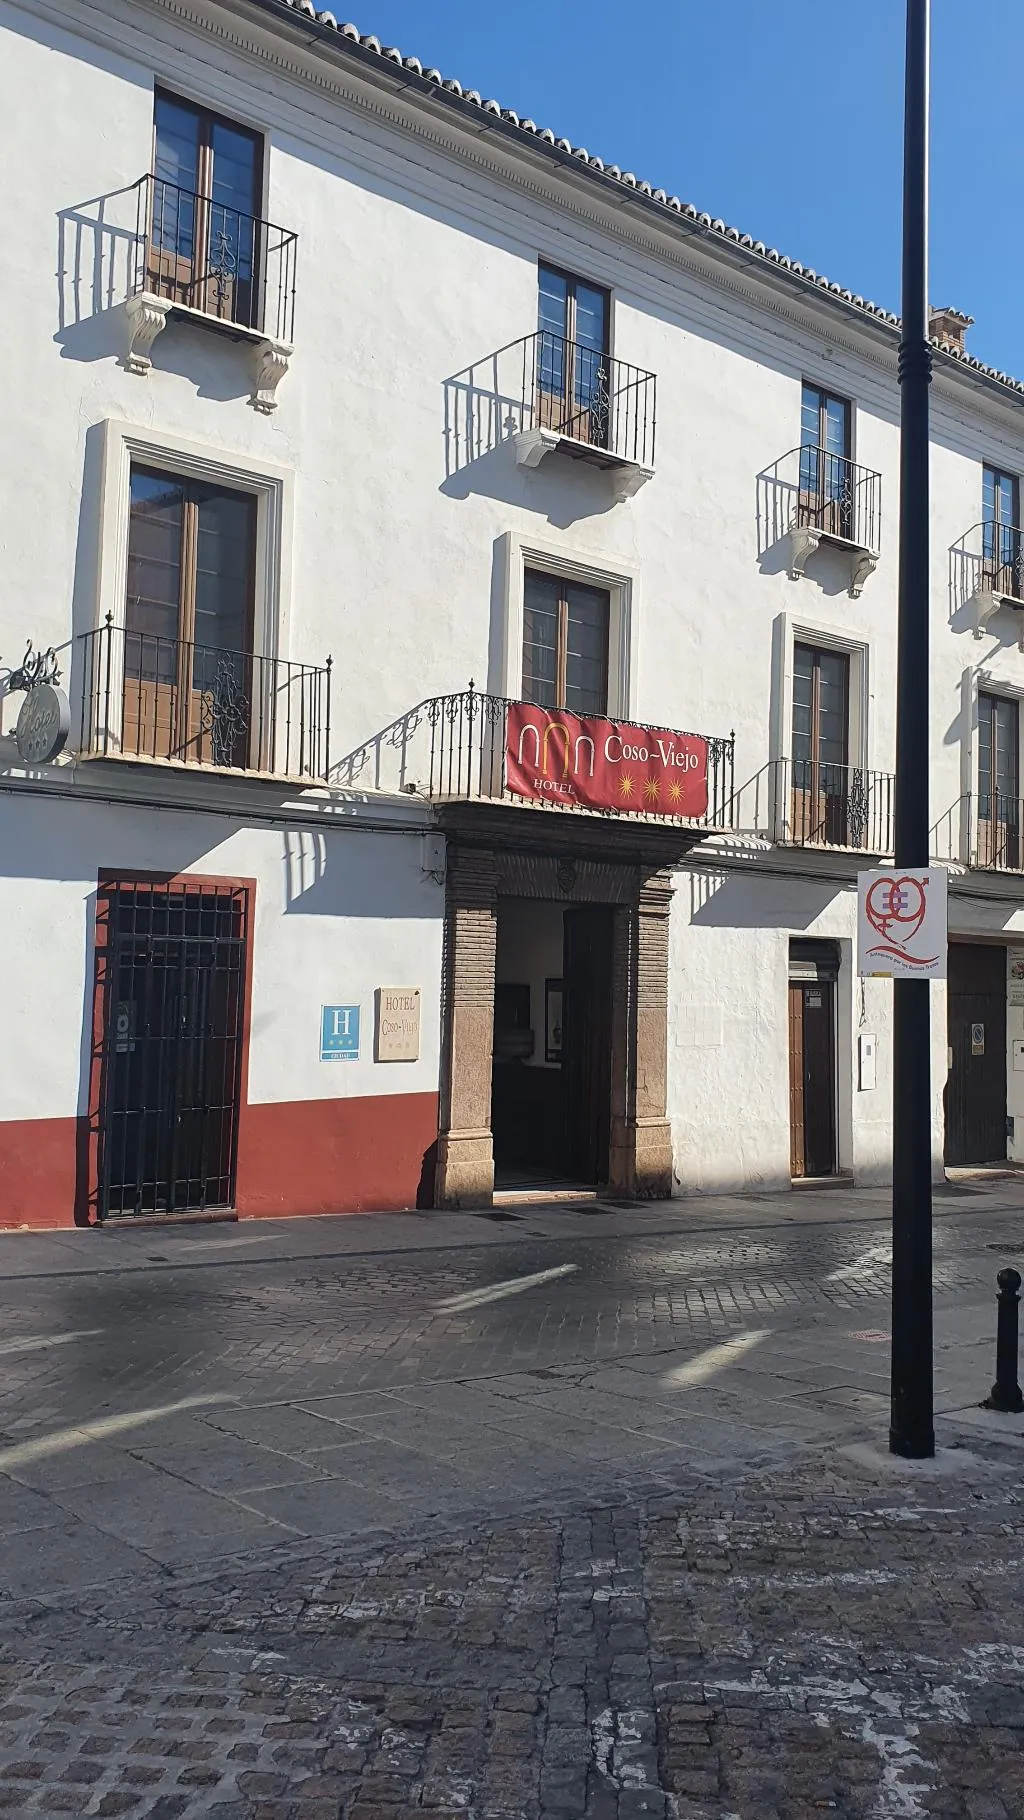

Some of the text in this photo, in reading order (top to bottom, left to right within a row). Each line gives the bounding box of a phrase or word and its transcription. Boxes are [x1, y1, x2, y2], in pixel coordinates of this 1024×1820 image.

[533, 778, 576, 795] HOTEL
[386, 997, 415, 1010] HOTEL
[331, 1009, 352, 1035] H
